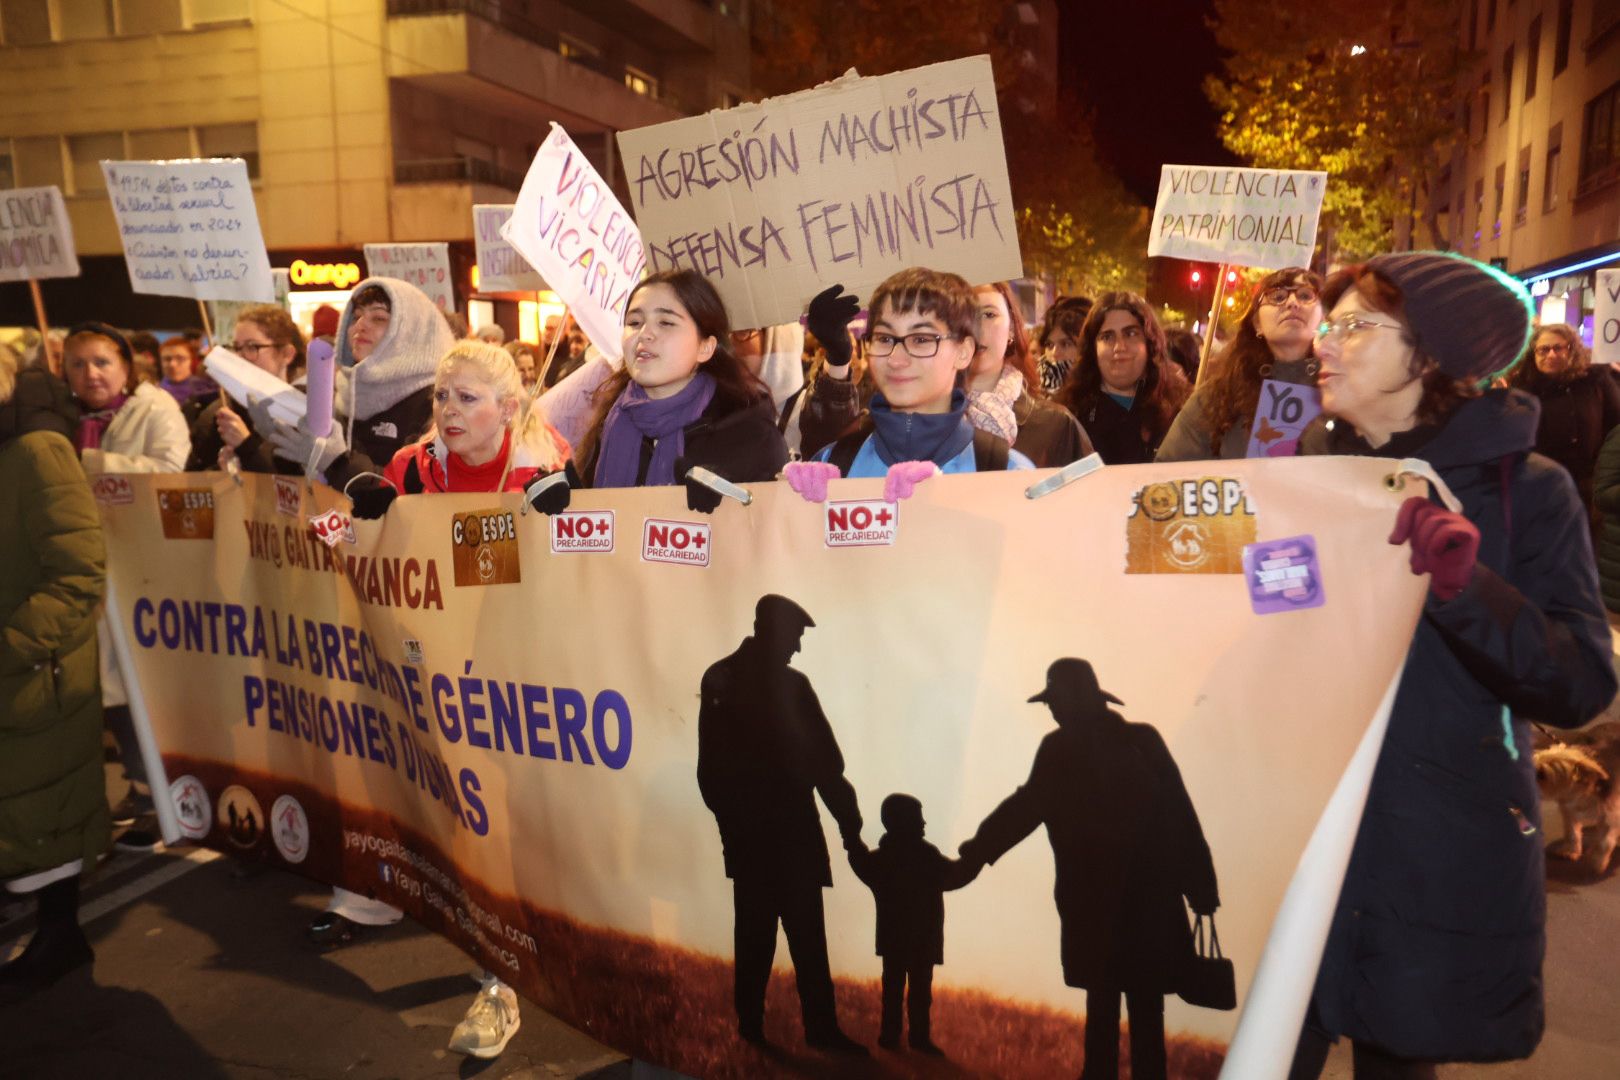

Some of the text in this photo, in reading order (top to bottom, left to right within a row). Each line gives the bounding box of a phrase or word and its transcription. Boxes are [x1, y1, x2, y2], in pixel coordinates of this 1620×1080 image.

[634, 87, 993, 208] AGRESIÓN MACHISTA
[192, 176, 235, 190] contra
[1170, 169, 1297, 198] VIOLENCIA
[190, 223, 205, 233] en
[648, 172, 1005, 279] DEFENSA FEMINISTA
[1160, 210, 1309, 246] PATRIMONIAL
[184, 247, 199, 258] no
[539, 195, 628, 327] VICARIA
[1267, 383, 1304, 424] Yo
[556, 539, 610, 549] PRECARIEDAD
[647, 547, 707, 563] PRECARIEDAD
[347, 555, 444, 611] MANCA
[134, 597, 270, 659] CONTRA
[272, 610, 304, 671] LA
[431, 660, 633, 770] GÉNERO
[243, 675, 398, 770] PENSIONES
